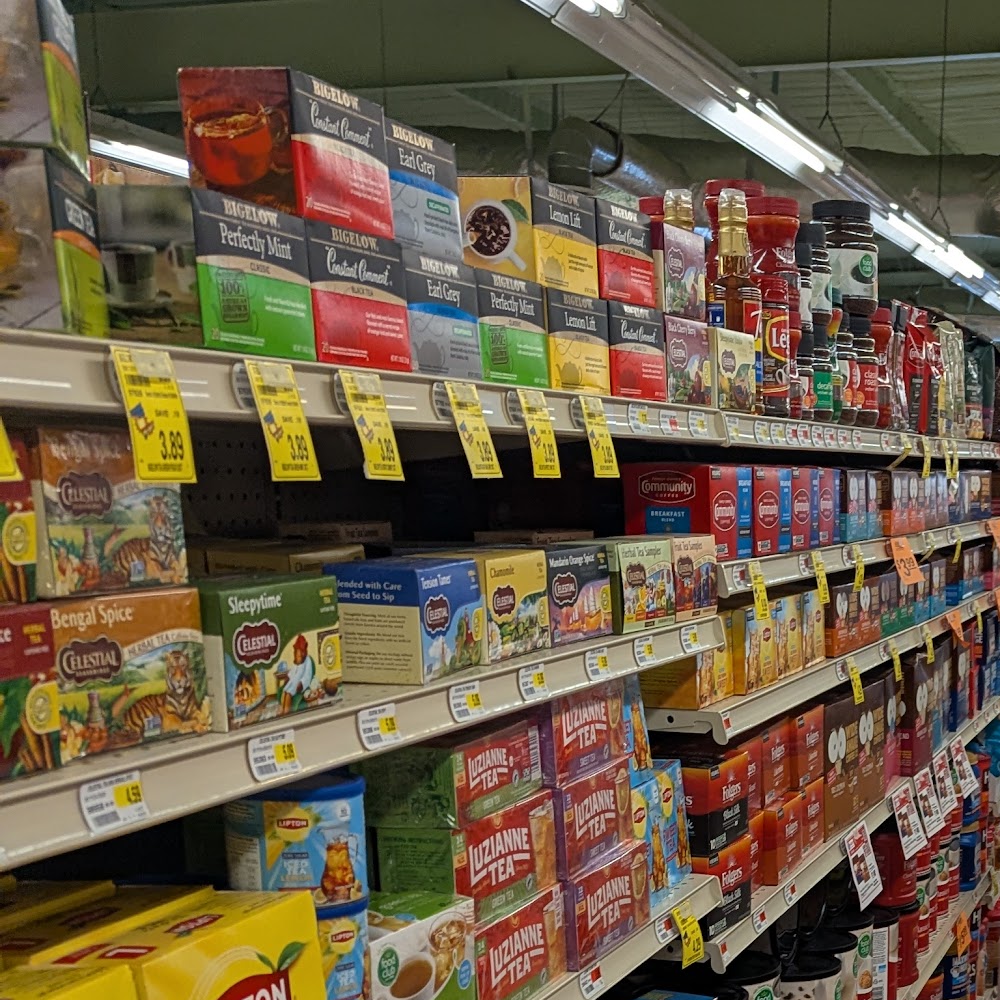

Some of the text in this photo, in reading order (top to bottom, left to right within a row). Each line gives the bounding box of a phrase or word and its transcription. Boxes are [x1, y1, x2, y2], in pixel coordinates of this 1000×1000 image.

[312, 79, 359, 110] BIGELOW
[392, 123, 434, 151] BIGELOW
[398, 148, 436, 181] Earl Grey
[549, 185, 580, 206] BIGELOW
[223, 199, 279, 228] BIGELOW
[549, 204, 581, 229] Lemon Lift
[219, 222, 293, 260] Perfectly Mint
[331, 227, 378, 251] BIGELOW
[419, 256, 459, 278] BIGELOW
[427, 279, 461, 307] Earl Grey
[492, 273, 526, 293] BIGELOW
[490, 292, 535, 317] Perfectly Mint
[564, 312, 597, 331] Lemon Lift
[159, 430, 185, 460] 3.89
[287, 434, 309, 461] 3.89
[641, 480, 694, 494] Community
[650, 510, 685, 518] BREAKFAST
[228, 592, 282, 617] Sleepytime
[351, 592, 369, 600] Seed
[372, 592, 380, 601] to
[382, 593, 395, 603] Sip
[51, 604, 134, 632] Bengal Spice
[236, 633, 277, 656] CELESTIAL
[62, 651, 120, 675] CELESTIAL
[562, 700, 608, 747] LUZIANNE
[578, 725, 598, 749] TEA
[468, 747, 508, 789] LUZIANNE
[481, 769, 499, 791] TEA
[722, 784, 742, 802] Folgers
[277, 818, 308, 829] LIPTON
[574, 788, 616, 840] LUZIANNE
[588, 815, 606, 840] TEA
[468, 827, 530, 888] LUZIANNE
[489, 858, 516, 887] TEA
[721, 866, 743, 889] Folgers
[587, 876, 632, 930] LUZIANNE
[601, 902, 621, 928] TEA
[332, 930, 355, 943] LIPTON
[382, 958, 396, 968] food
[489, 923, 545, 989] LUZIANNE
[382, 966, 396, 977] club
[507, 954, 532, 985] TEA
